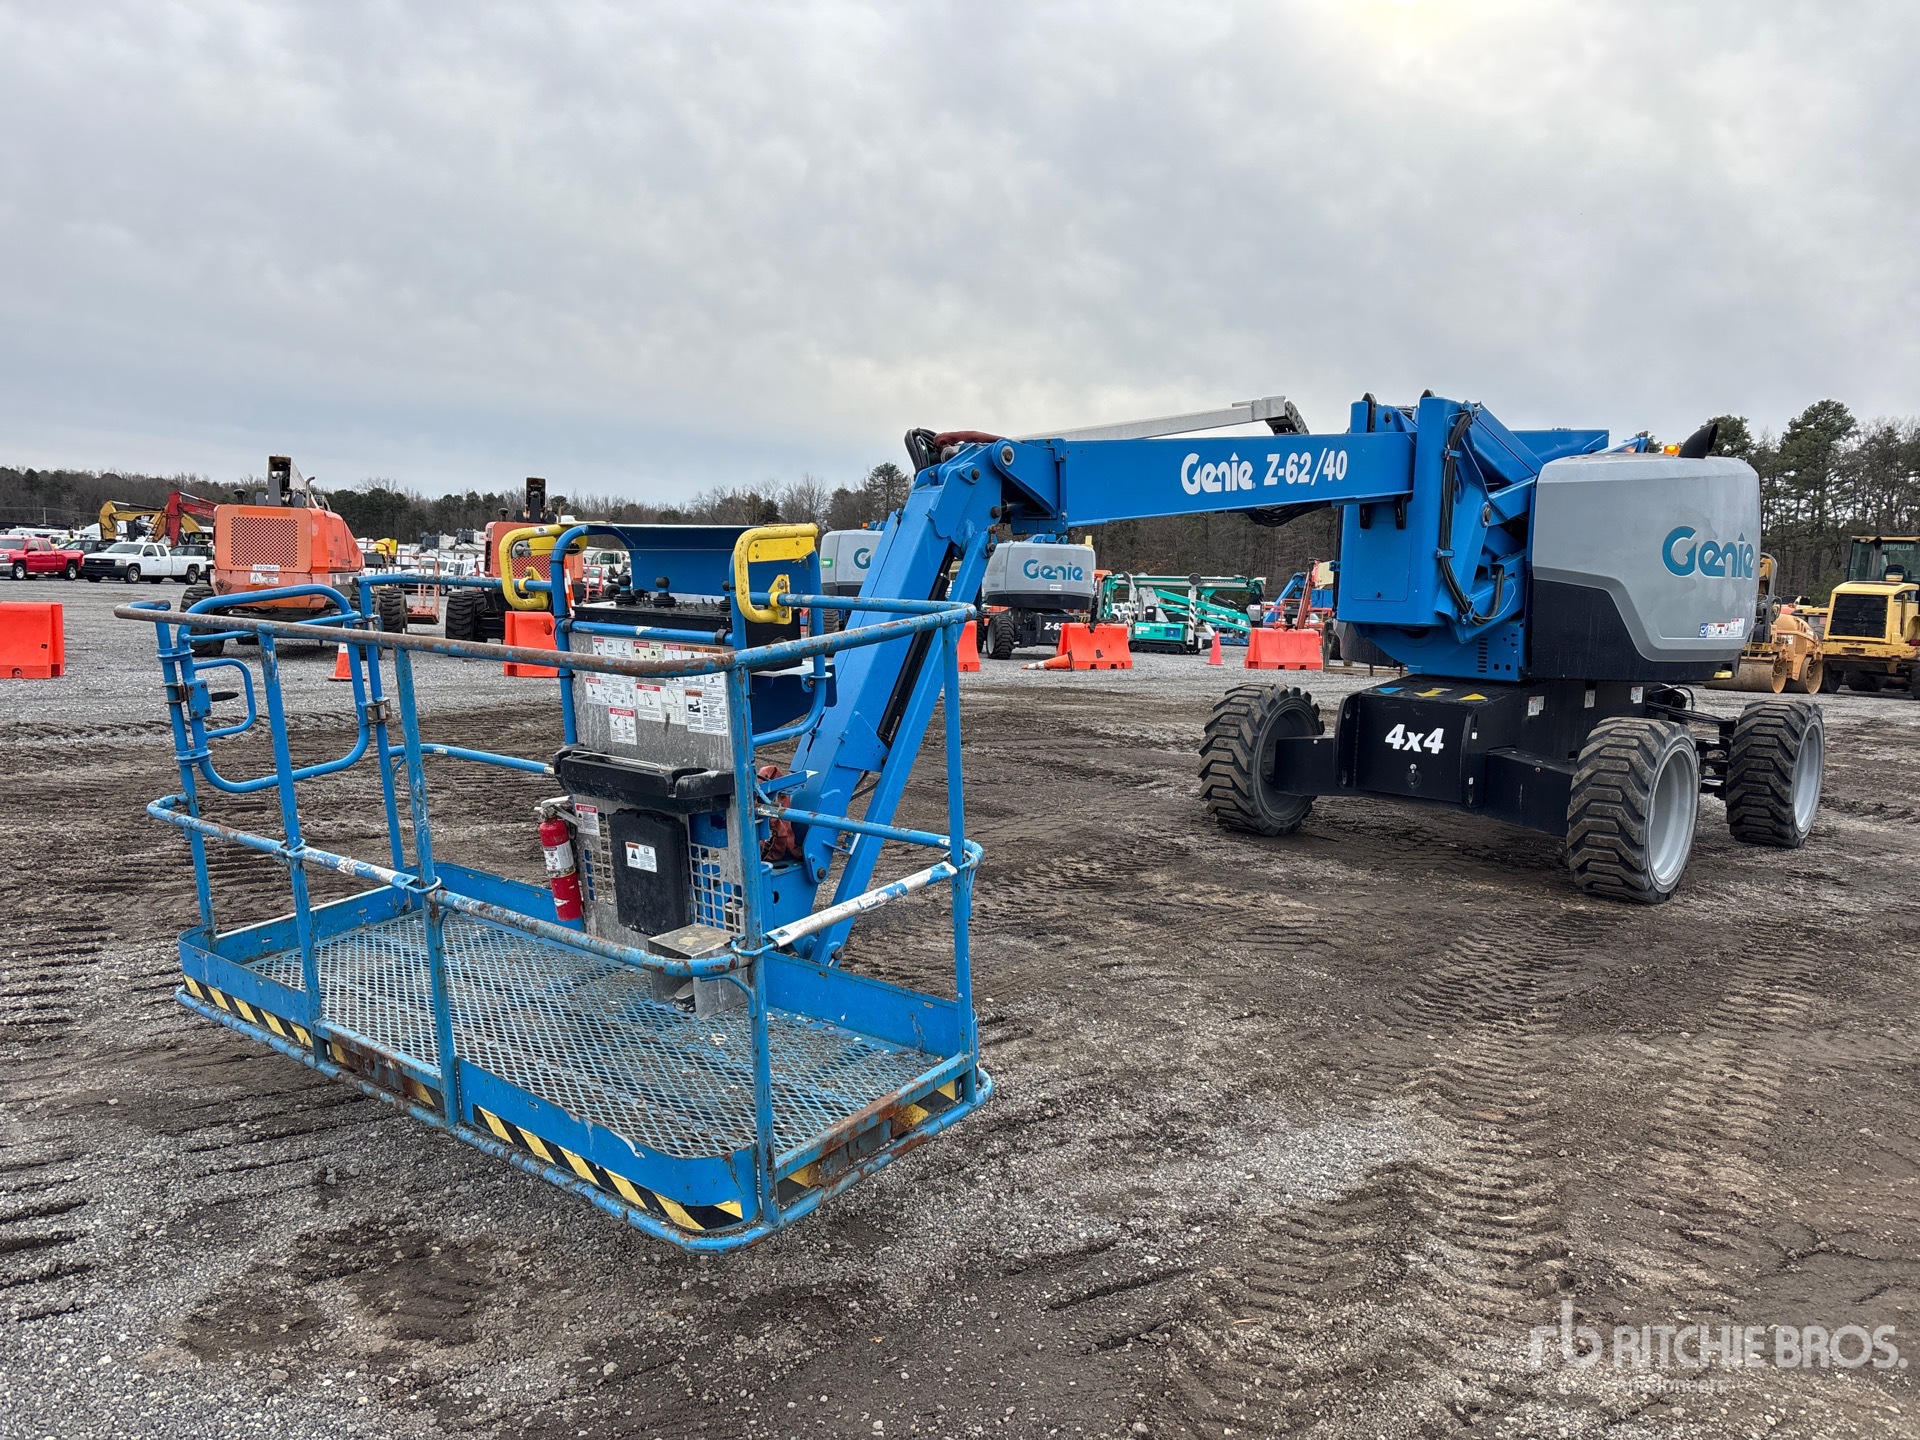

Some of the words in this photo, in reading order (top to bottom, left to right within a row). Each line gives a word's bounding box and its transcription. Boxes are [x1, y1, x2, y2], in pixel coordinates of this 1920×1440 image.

[1181, 452, 1254, 495] Genie
[1263, 448, 1348, 486] Z-62/40
[1023, 559, 1083, 581] Genie
[1662, 526, 1754, 579] Genie
[1385, 723, 1444, 754] 4x4
